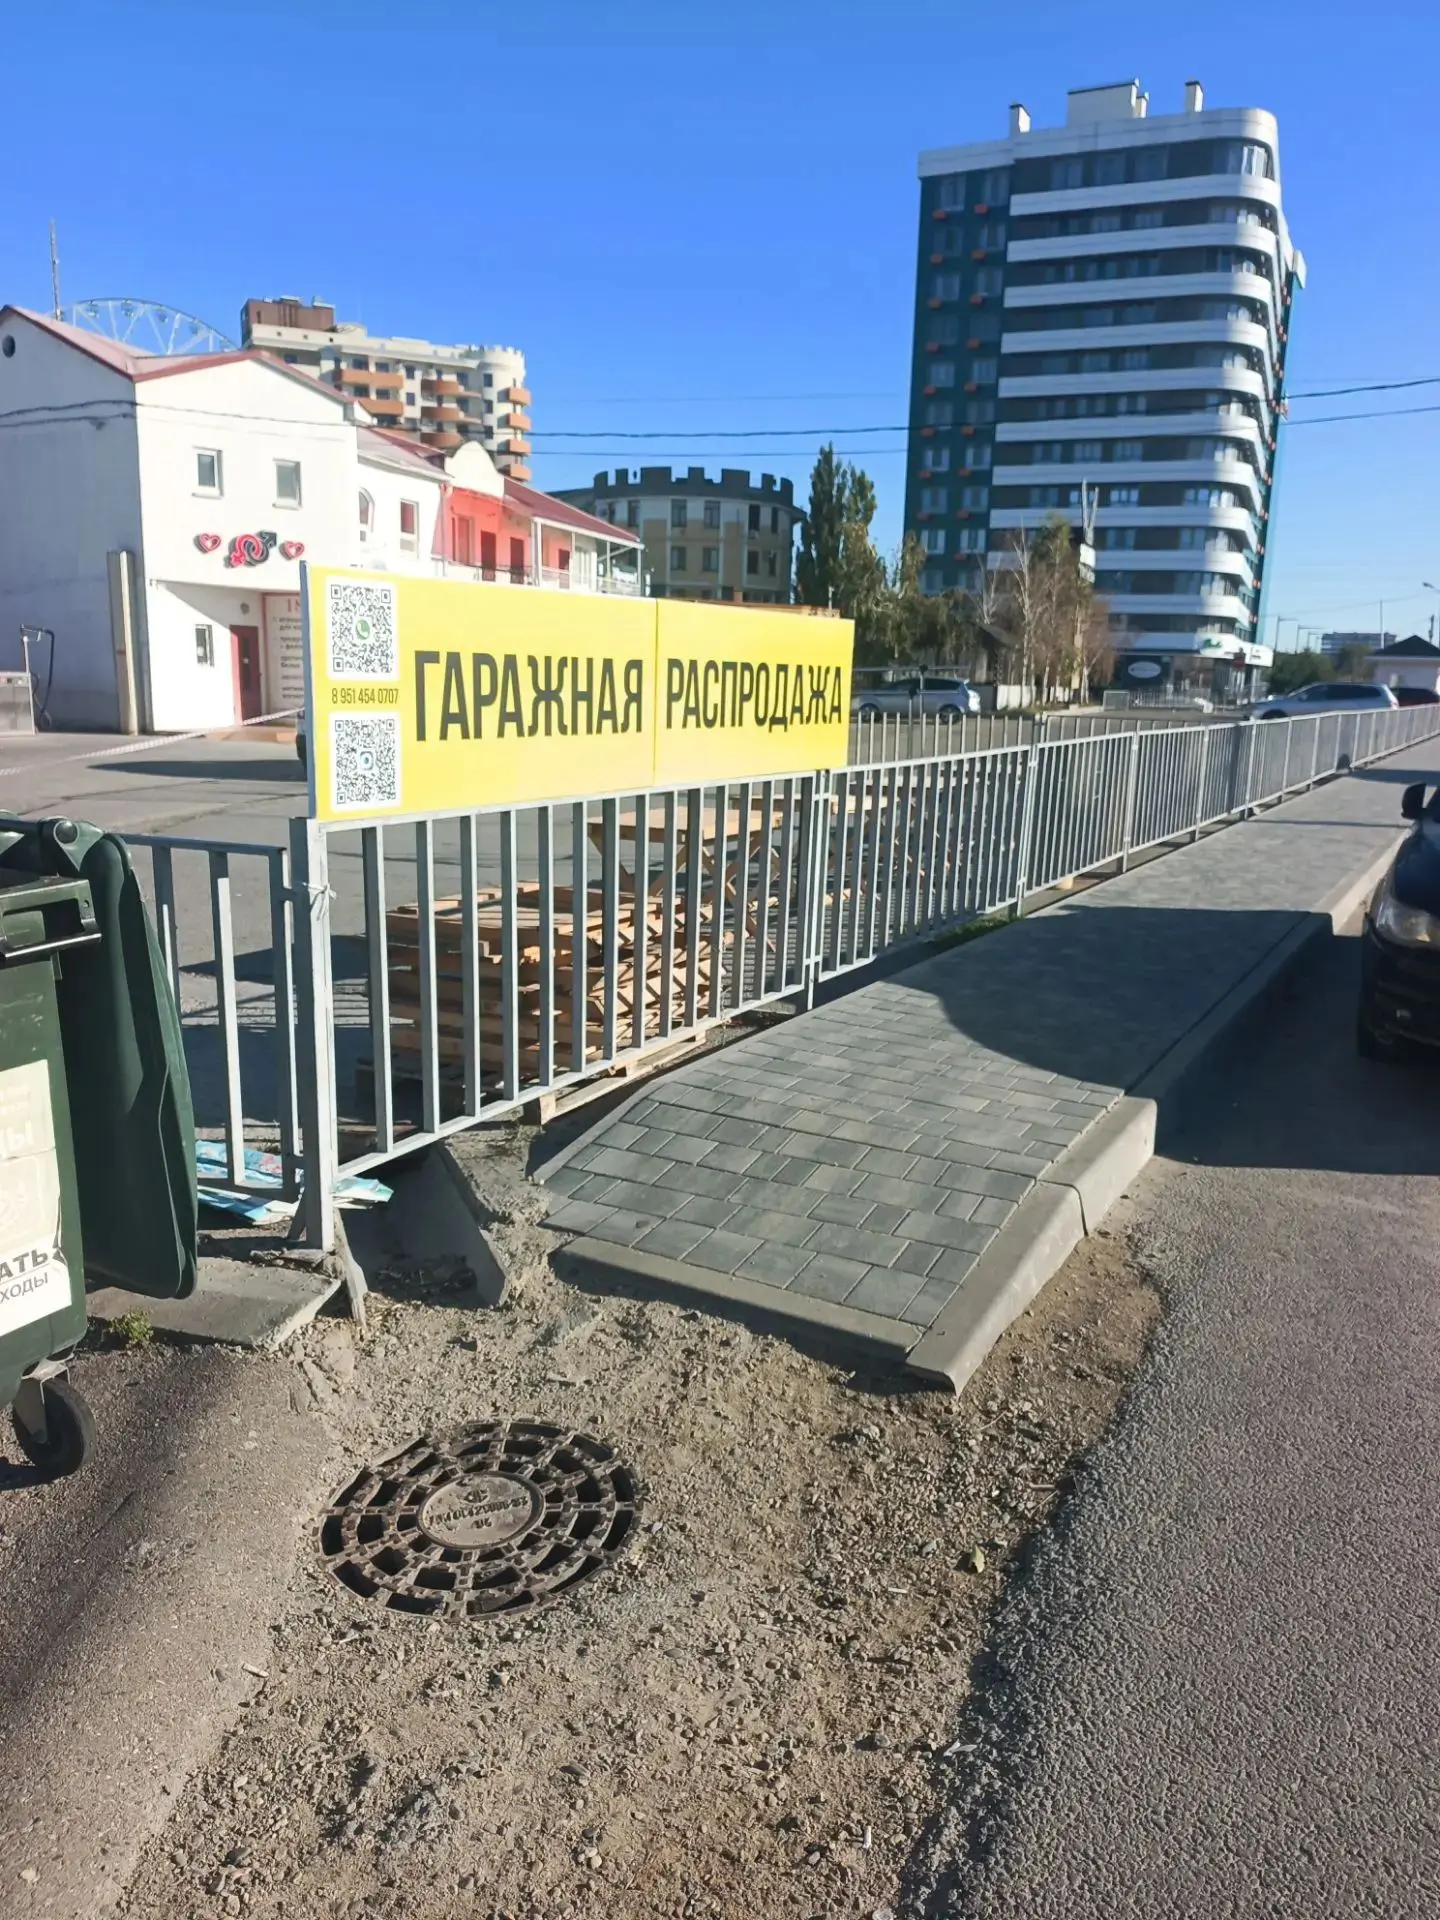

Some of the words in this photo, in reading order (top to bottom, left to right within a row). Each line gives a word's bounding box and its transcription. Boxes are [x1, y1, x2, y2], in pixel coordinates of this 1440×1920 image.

[331, 687, 338, 705] 8
[340, 687, 356, 705] 951
[358, 688, 375, 705] 454
[377, 688, 399, 705] 0707
[414, 650, 643, 742] ГАРАЖНАЯ
[666, 658, 842, 733] РАСПРОДАЖА
